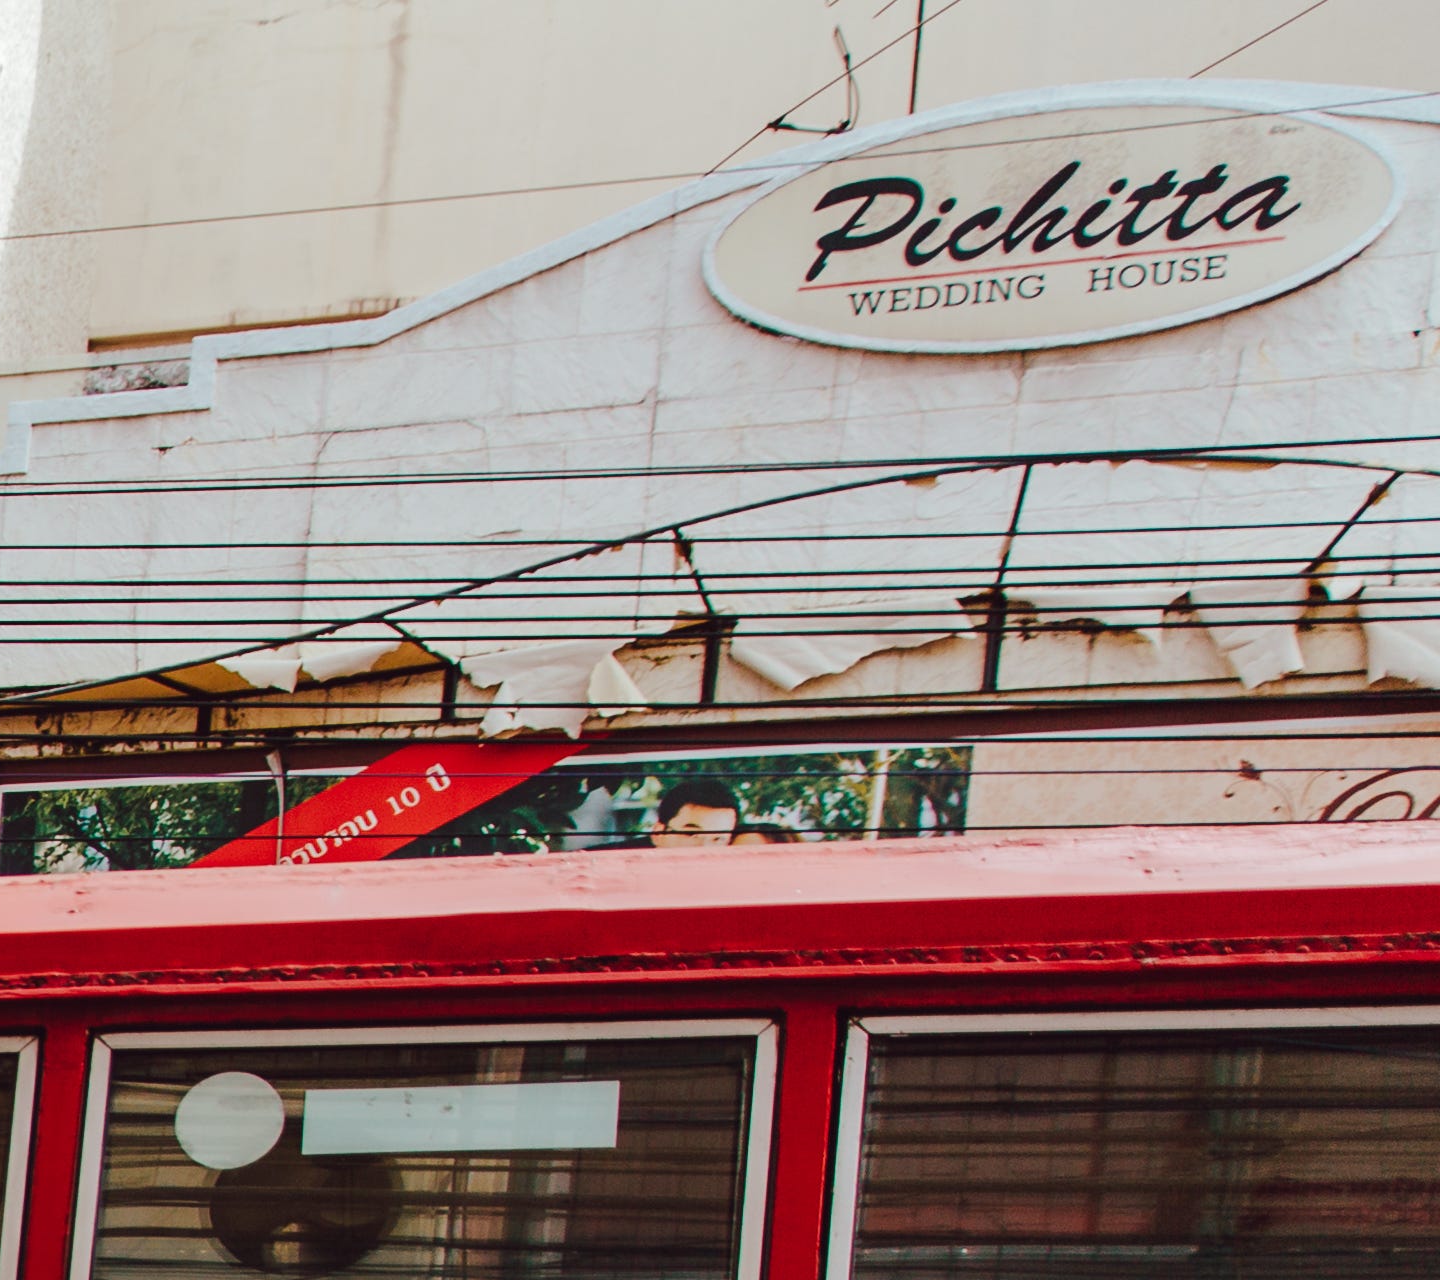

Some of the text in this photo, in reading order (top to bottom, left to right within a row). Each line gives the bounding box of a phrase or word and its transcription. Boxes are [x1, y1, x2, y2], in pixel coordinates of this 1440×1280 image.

[805, 160, 1303, 283] Pichitta
[848, 254, 1228, 317] WEDDING HOUSE
[385, 785, 421, 817] 10
[424, 762, 453, 793] ปี
